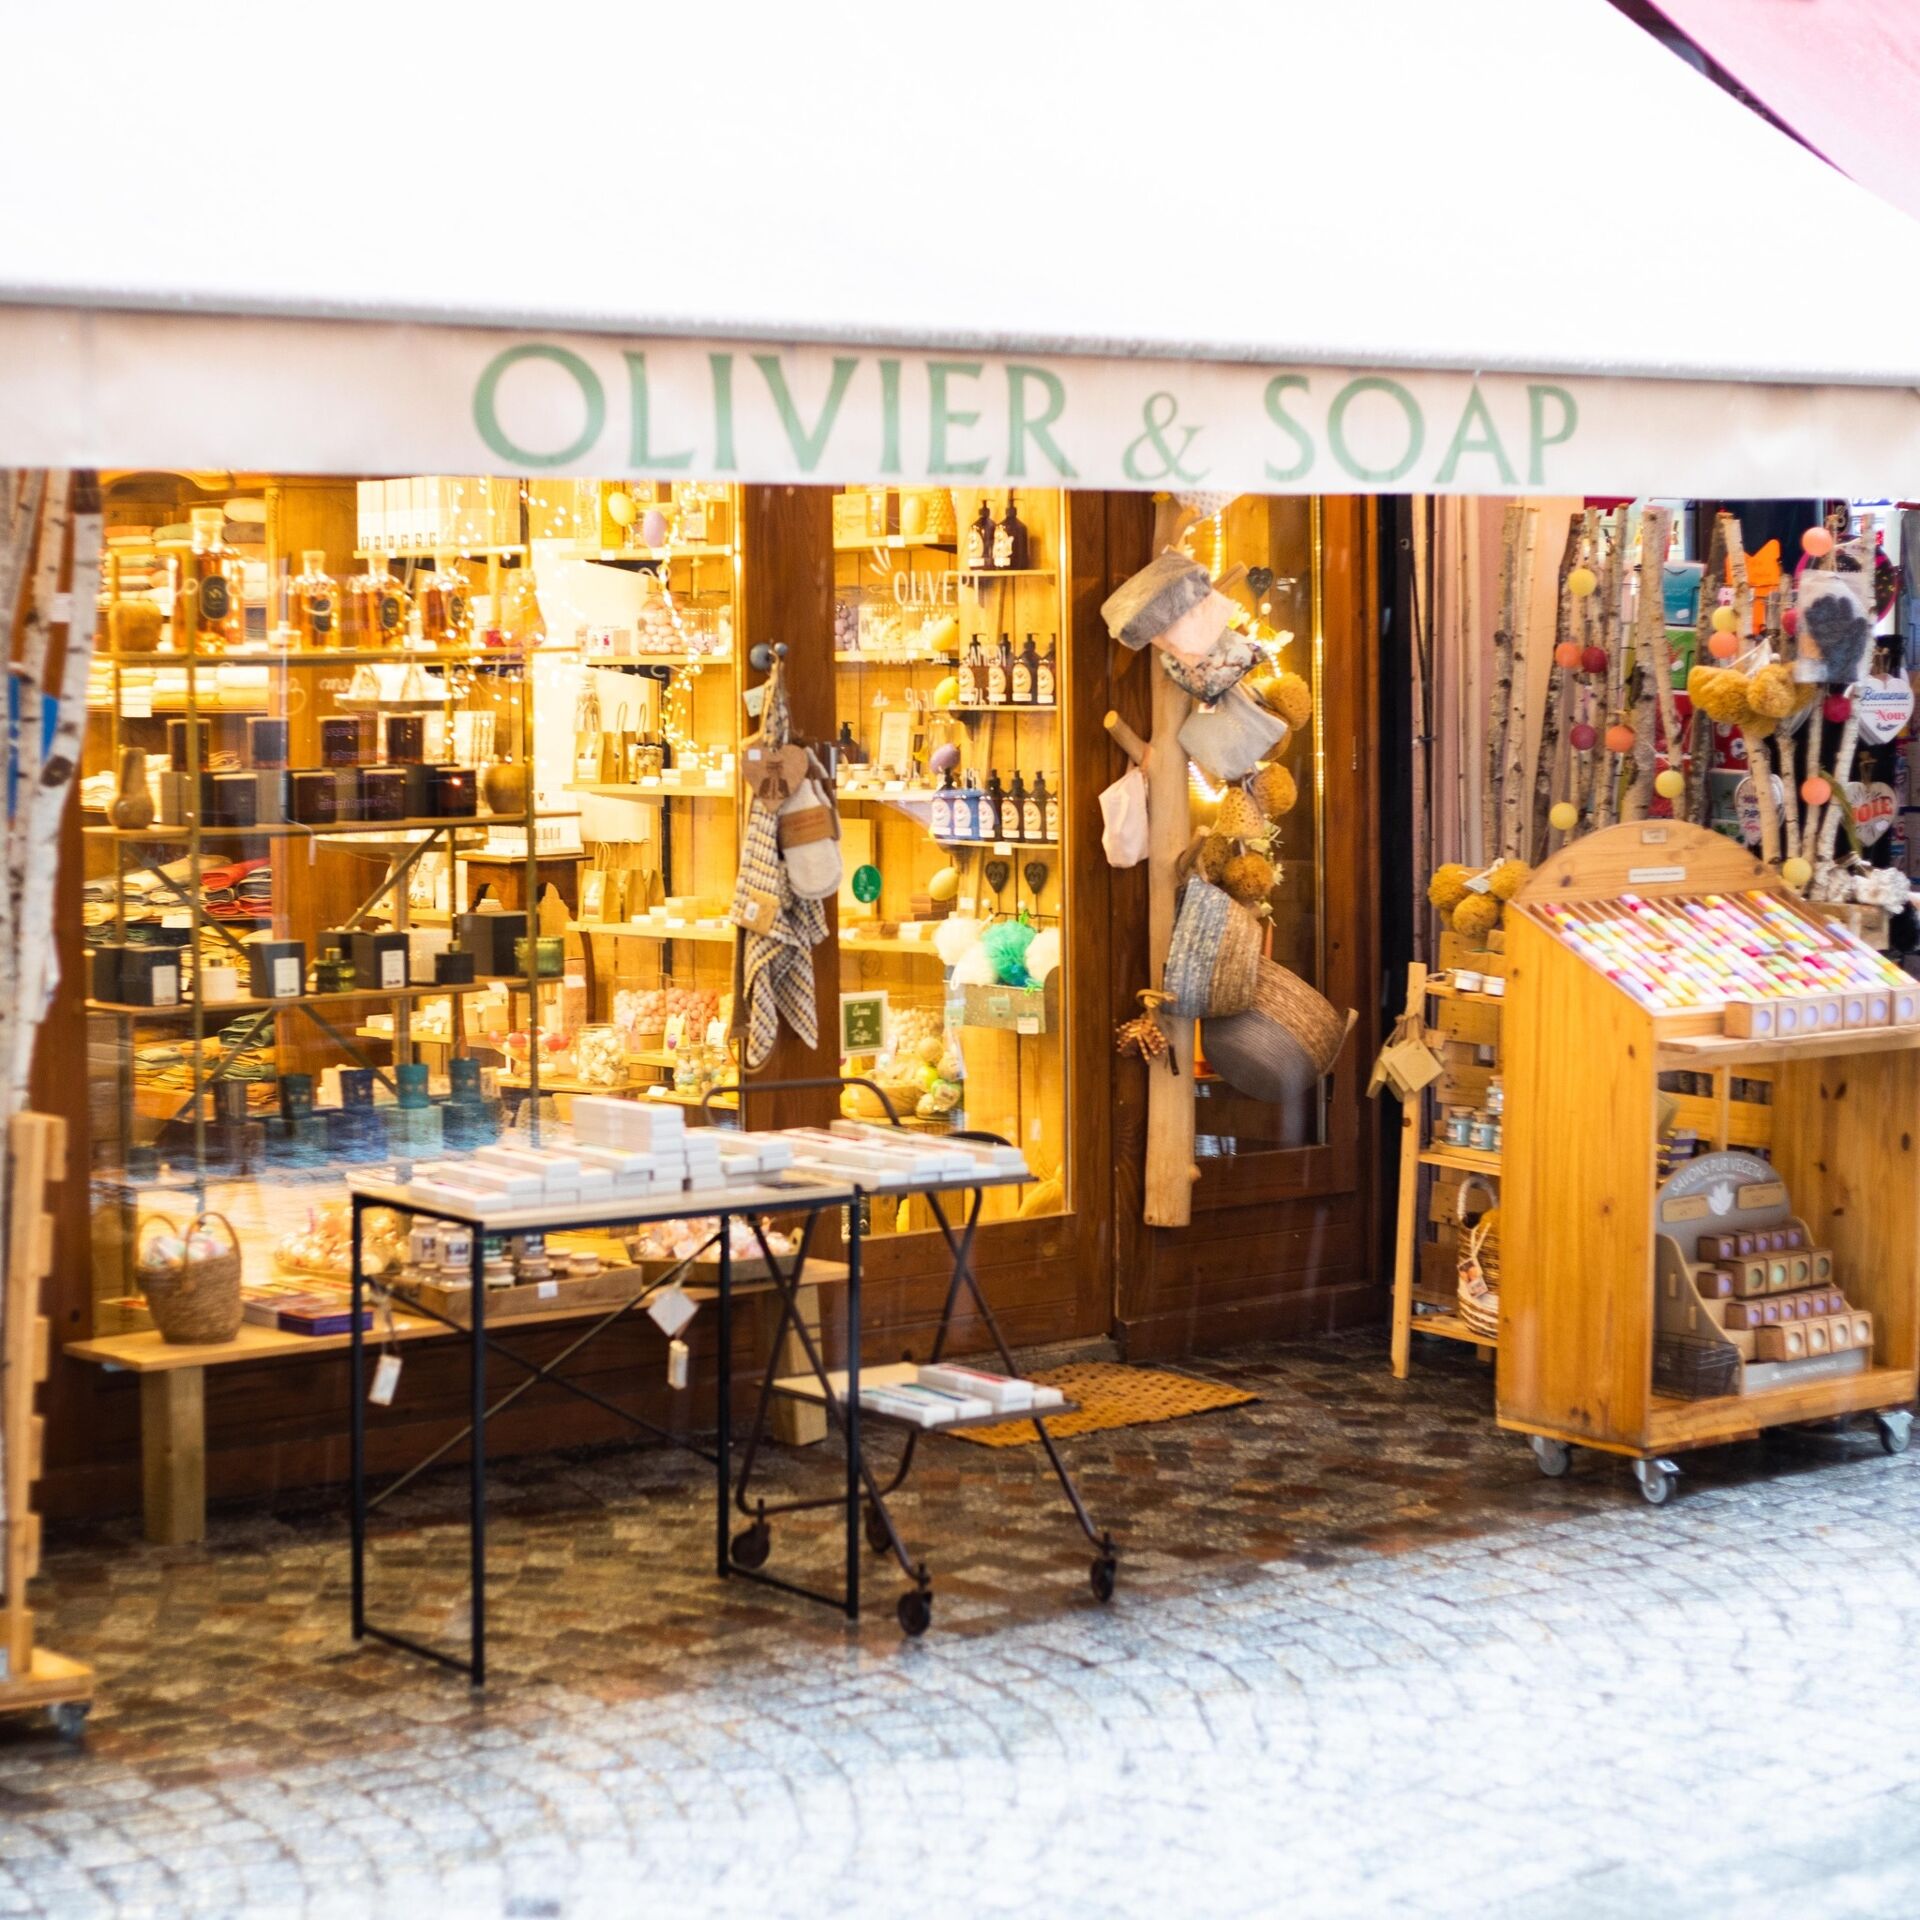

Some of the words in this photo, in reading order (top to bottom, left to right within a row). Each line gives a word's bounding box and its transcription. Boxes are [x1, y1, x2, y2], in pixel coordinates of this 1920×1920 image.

[472, 343, 1079, 479] OLIVIER
[1122, 391, 1211, 483] &
[1264, 374, 1580, 486] SOAP
[893, 570, 979, 606] OUVERT
[1875, 709, 1907, 721] Nous
